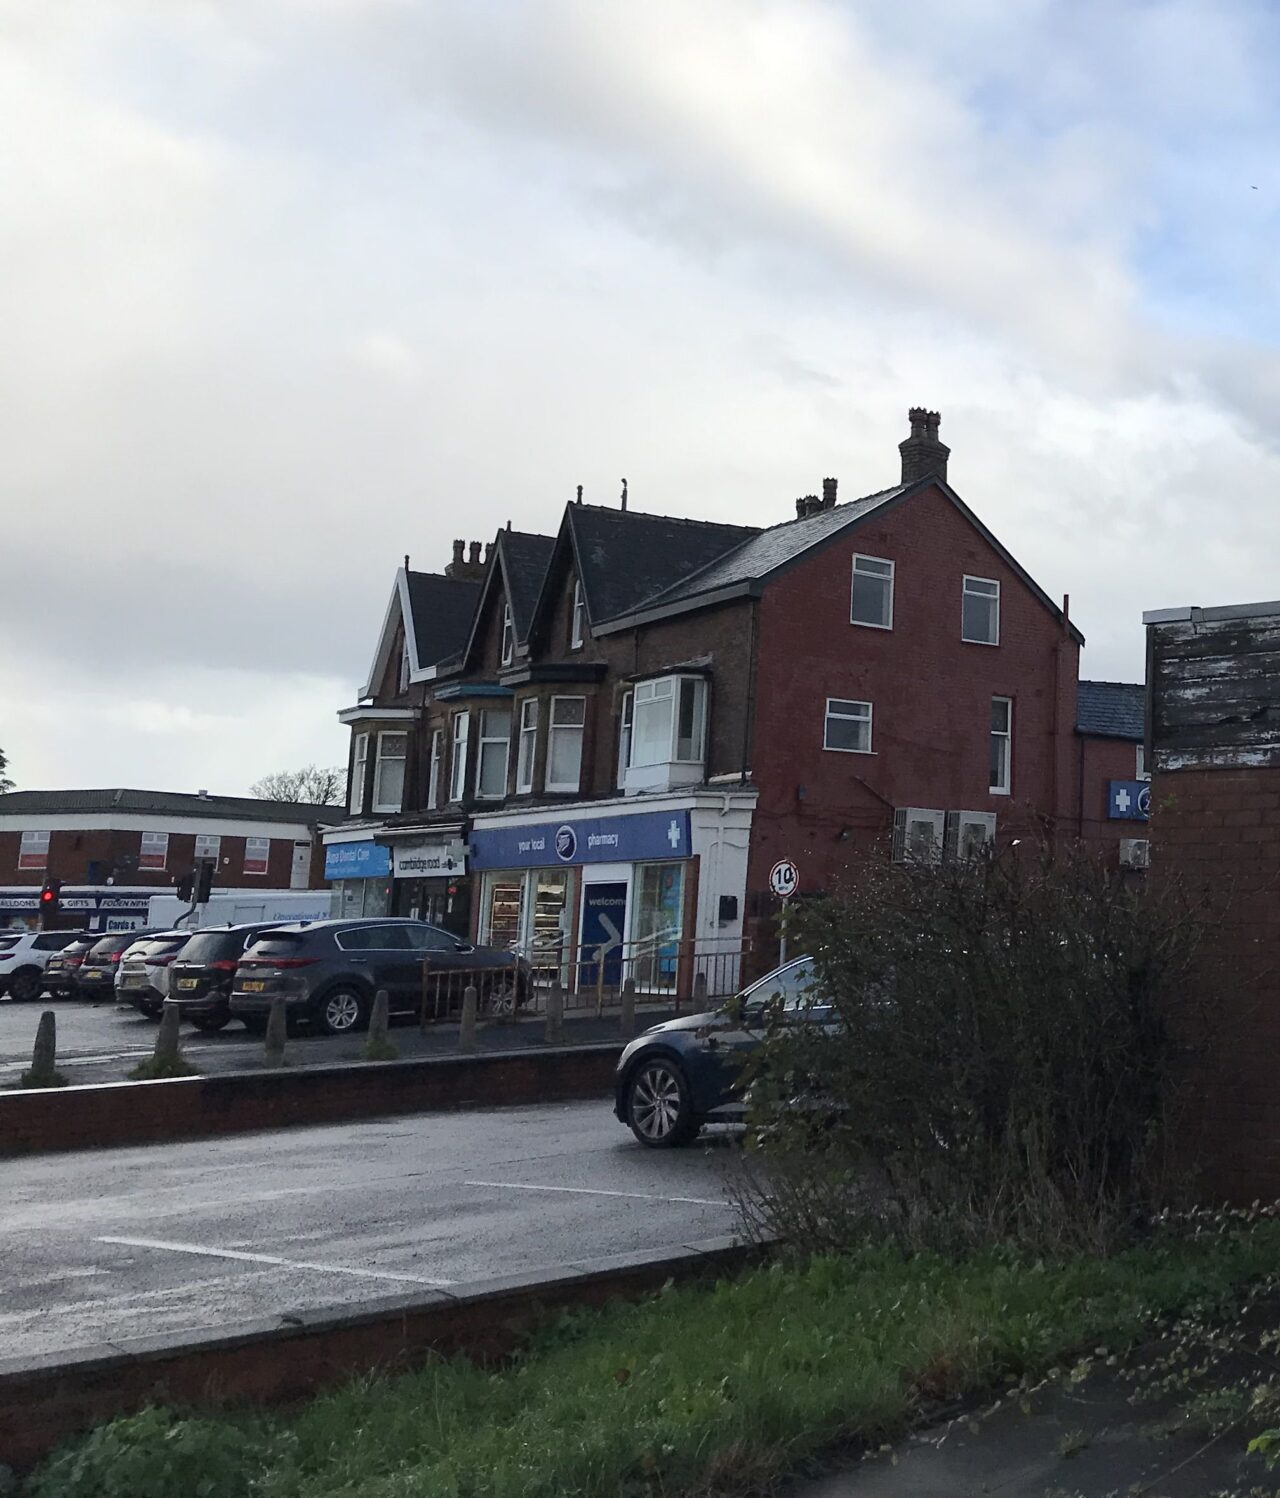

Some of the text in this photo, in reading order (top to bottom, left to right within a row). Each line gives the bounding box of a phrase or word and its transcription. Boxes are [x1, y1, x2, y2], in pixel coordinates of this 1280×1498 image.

[518, 840, 531, 854] your
[532, 838, 545, 850] local
[587, 833, 619, 848] pharmacy
[776, 867, 792, 884] 10
[589, 897, 627, 907] welcom
